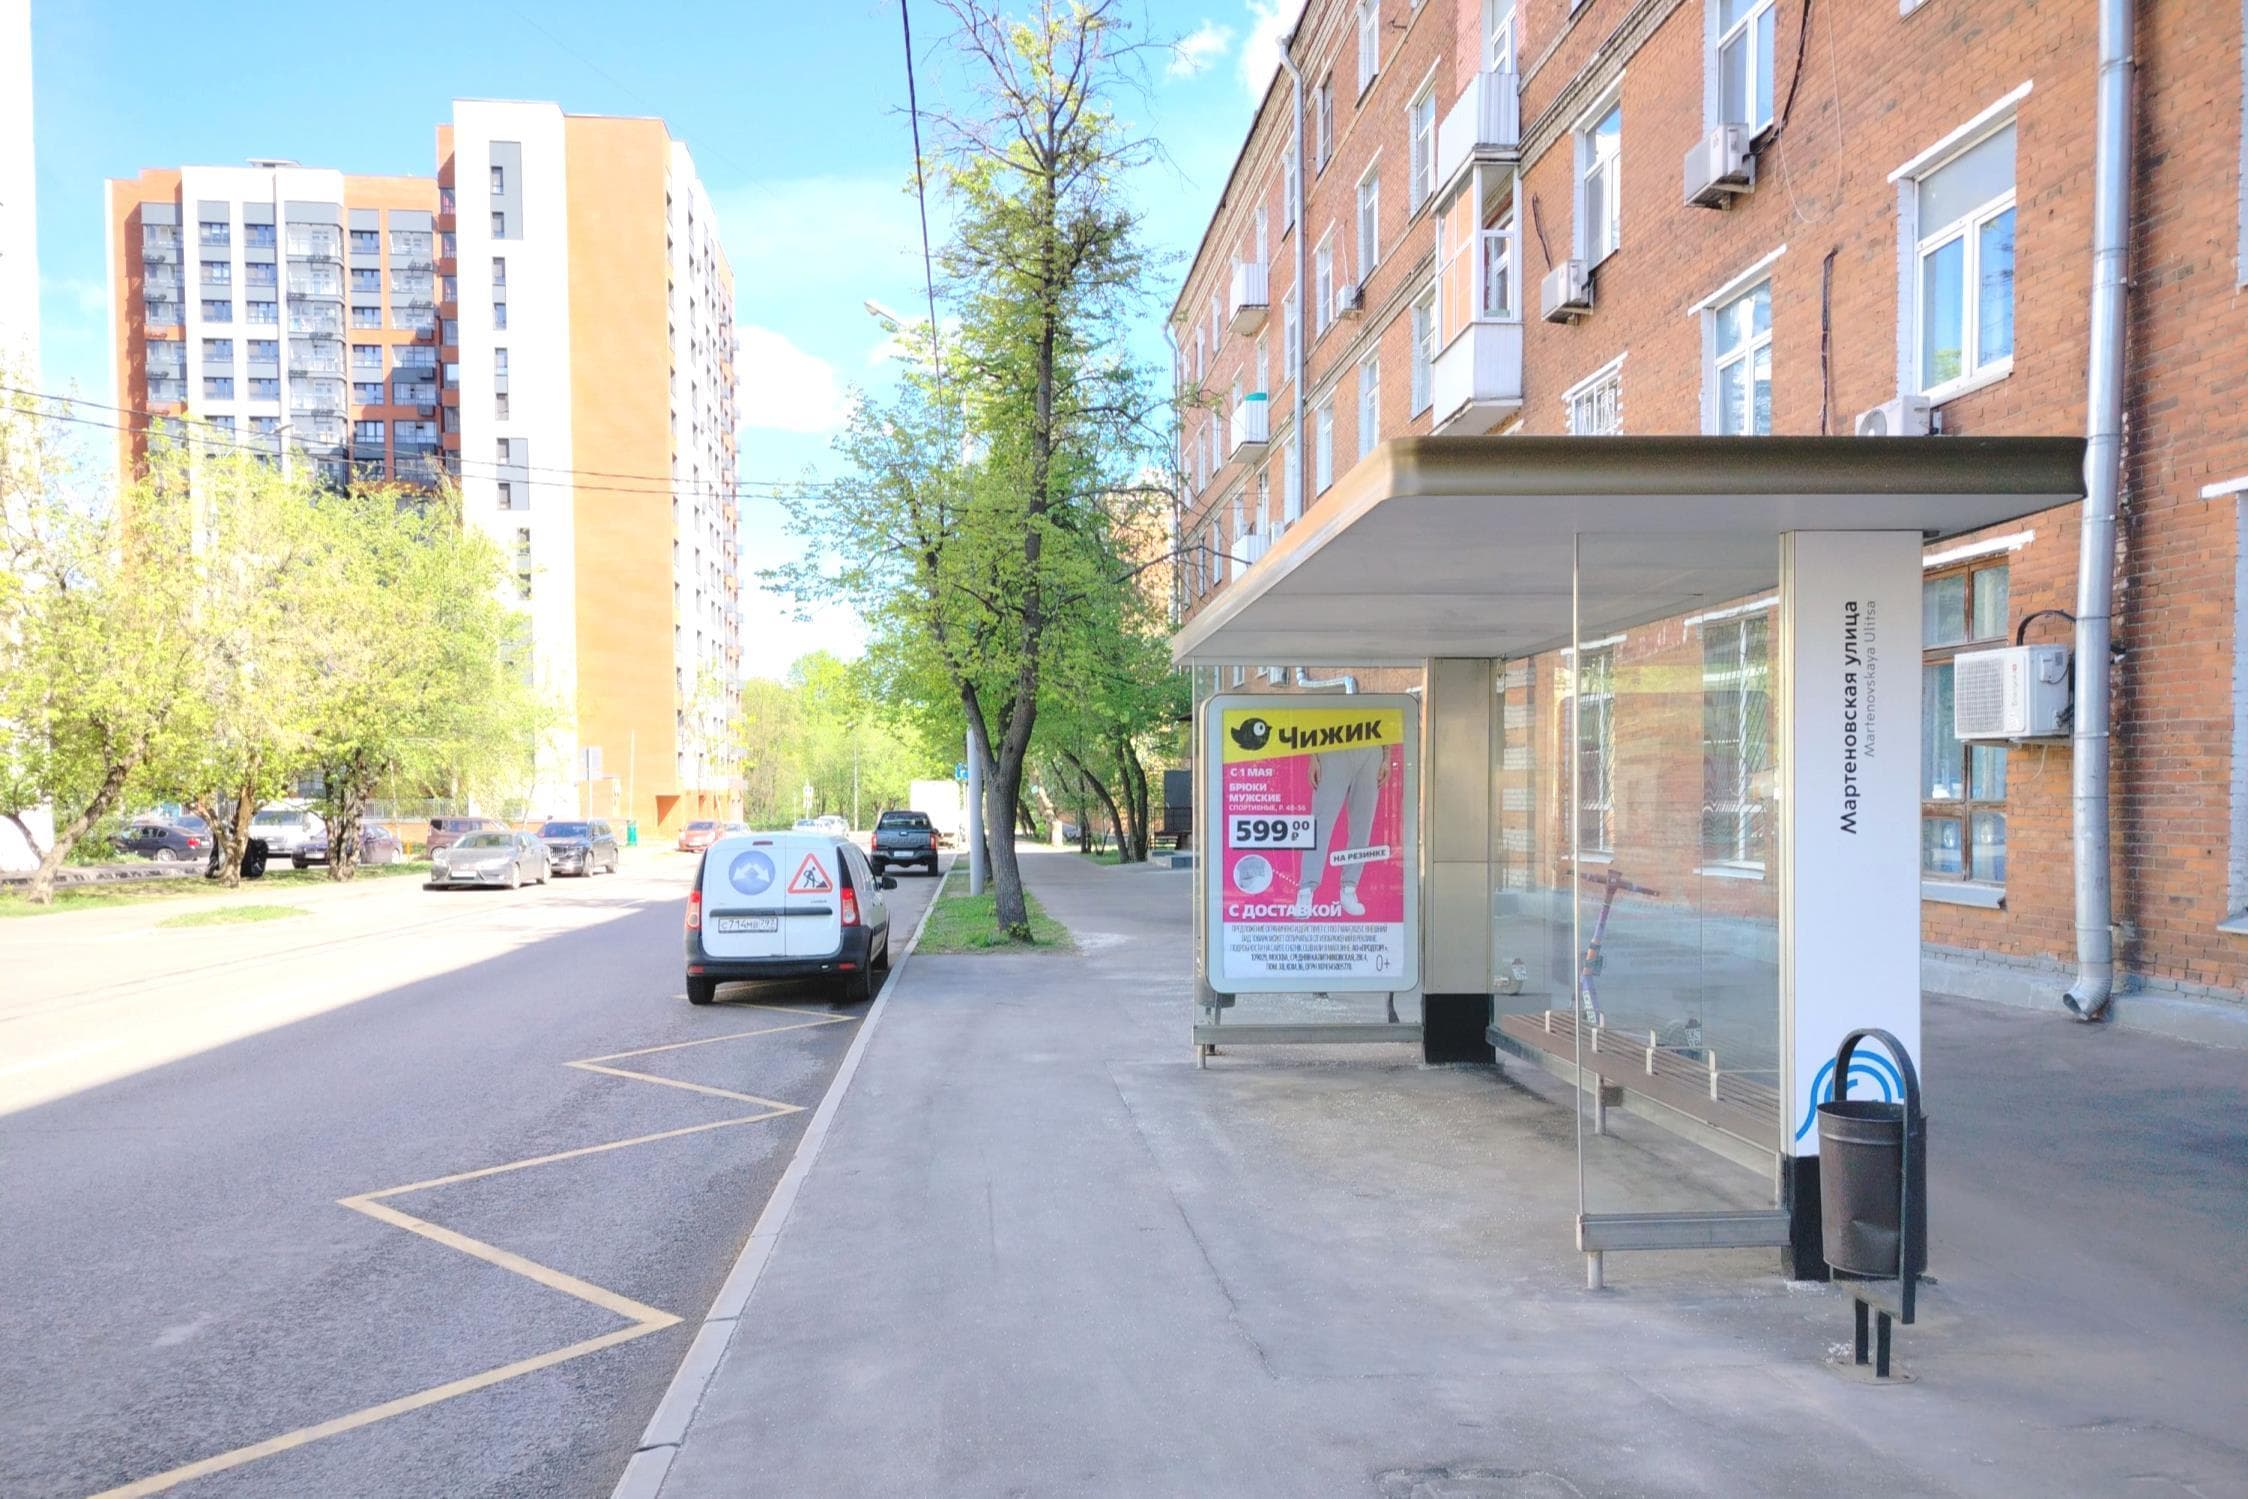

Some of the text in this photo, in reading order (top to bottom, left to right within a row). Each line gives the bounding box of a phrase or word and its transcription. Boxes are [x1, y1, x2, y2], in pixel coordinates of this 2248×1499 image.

[1863, 600, 1878, 757] Martenovskaya Ulitsa
[1840, 601, 1861, 834] Мартеновская улица
[1230, 768, 1237, 777] С
[1247, 768, 1273, 777] МАЯ
[1229, 783, 1267, 792] БРЮКИ
[1229, 794, 1281, 802] МУЖСКИЕ
[1236, 820, 1310, 842] 599 00
[1333, 849, 1386, 863] НА РЕЗИНКЕ
[1228, 900, 1342, 919] С ДОСТАВКОЙ
[1375, 953, 1391, 973] 0+
